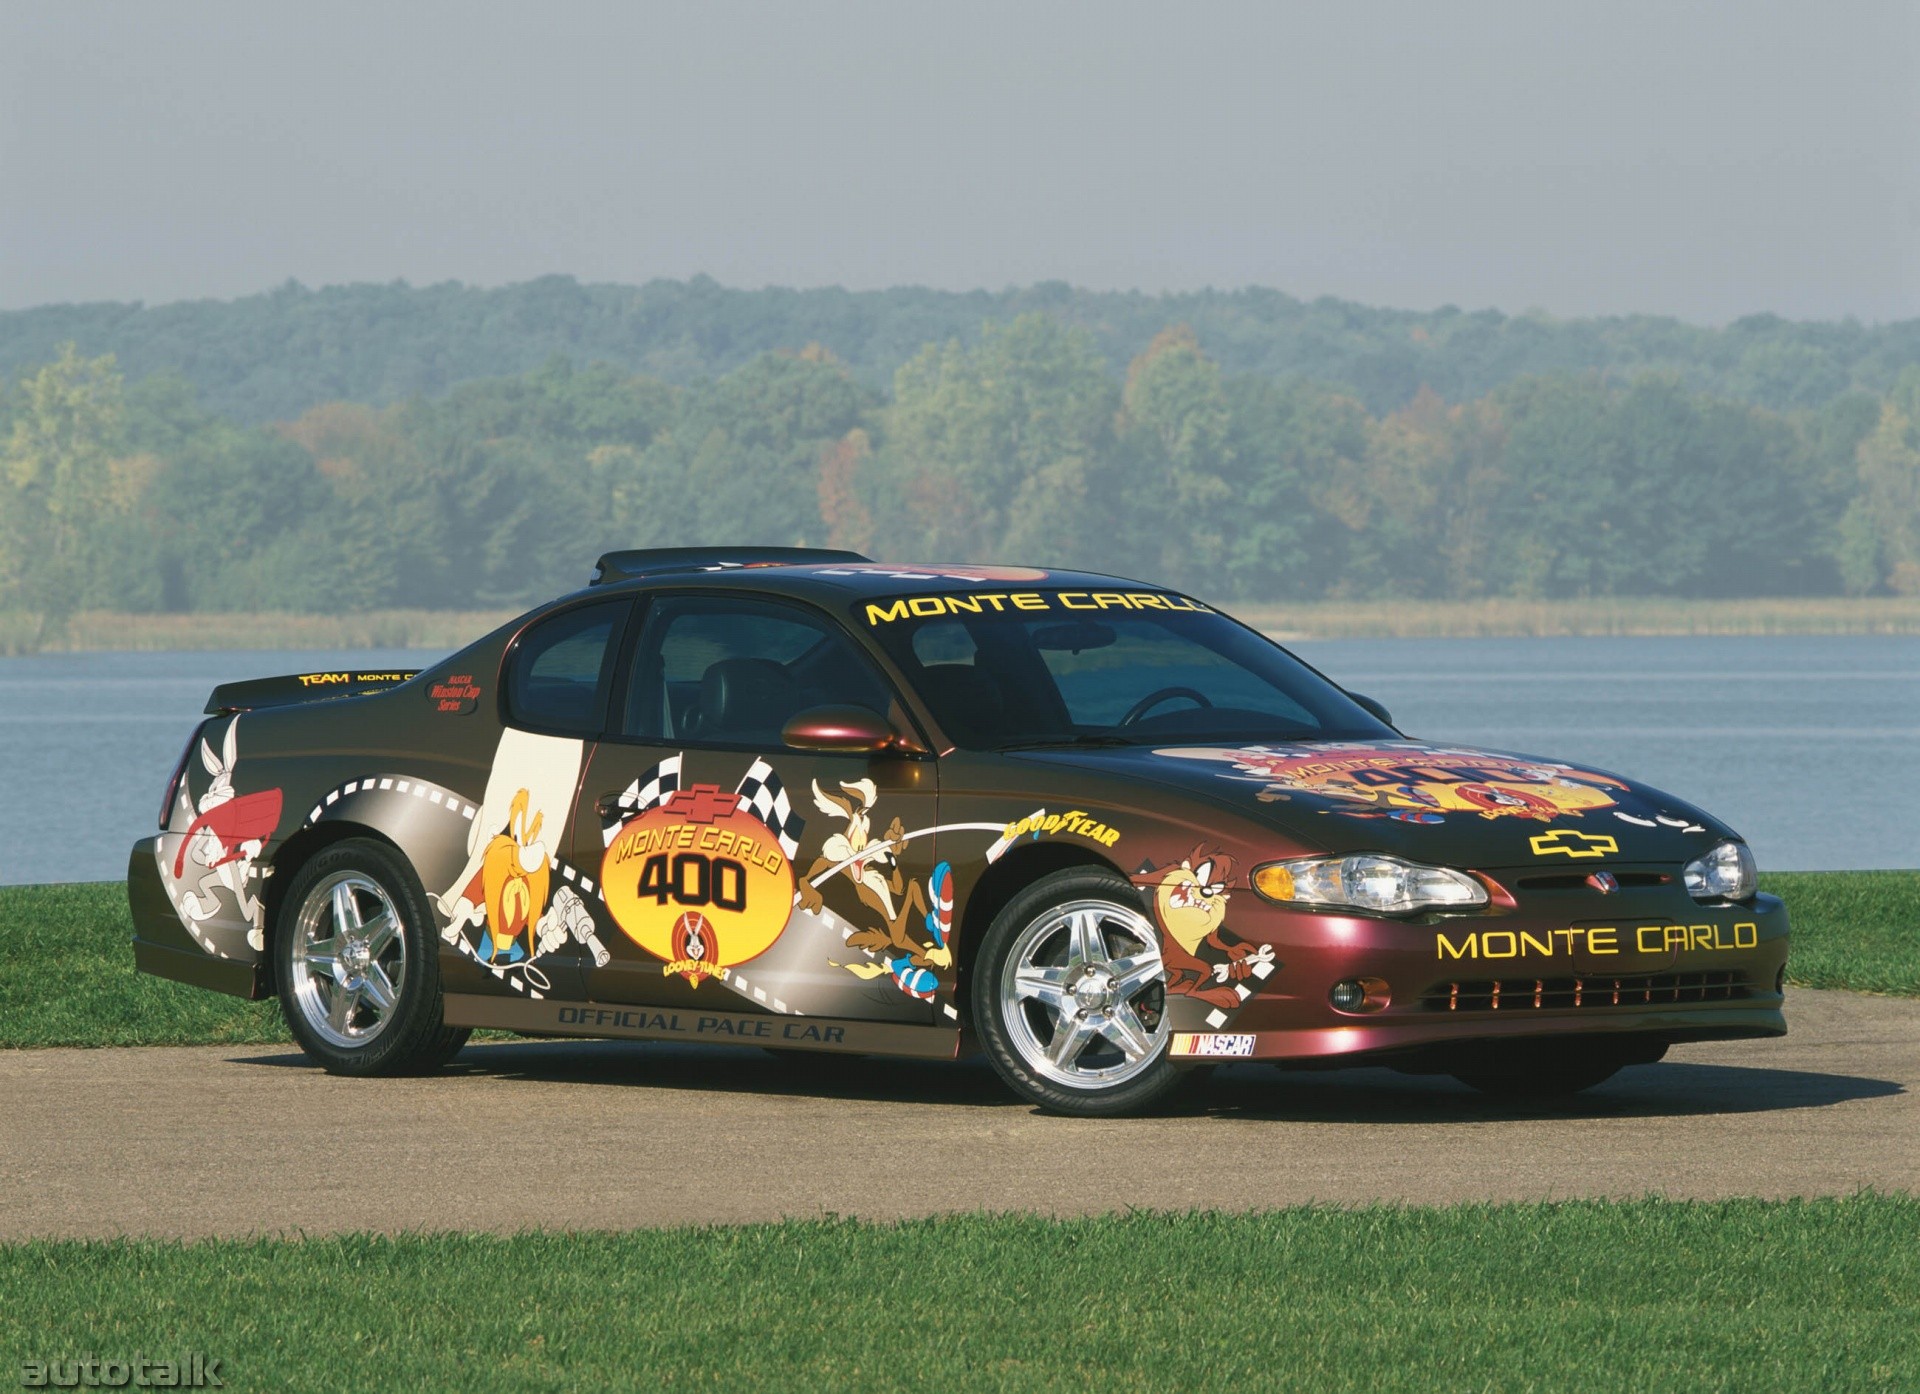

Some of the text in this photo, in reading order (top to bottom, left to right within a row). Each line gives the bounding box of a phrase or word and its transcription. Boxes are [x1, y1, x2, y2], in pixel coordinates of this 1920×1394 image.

[866, 592, 1217, 626] MONTE CARLO
[299, 673, 349, 687] TEAM
[431, 684, 480, 700] Winston Cup
[437, 700, 461, 711] Series
[1003, 810, 1120, 847] GOODYEAR
[616, 825, 783, 875] MONTE CARLO
[637, 852, 747, 913] 400
[1437, 922, 1757, 959] MONTE CARLO
[558, 1007, 845, 1043] OFFICIAL PACE CAR
[1199, 1034, 1252, 1055] NASCAR
